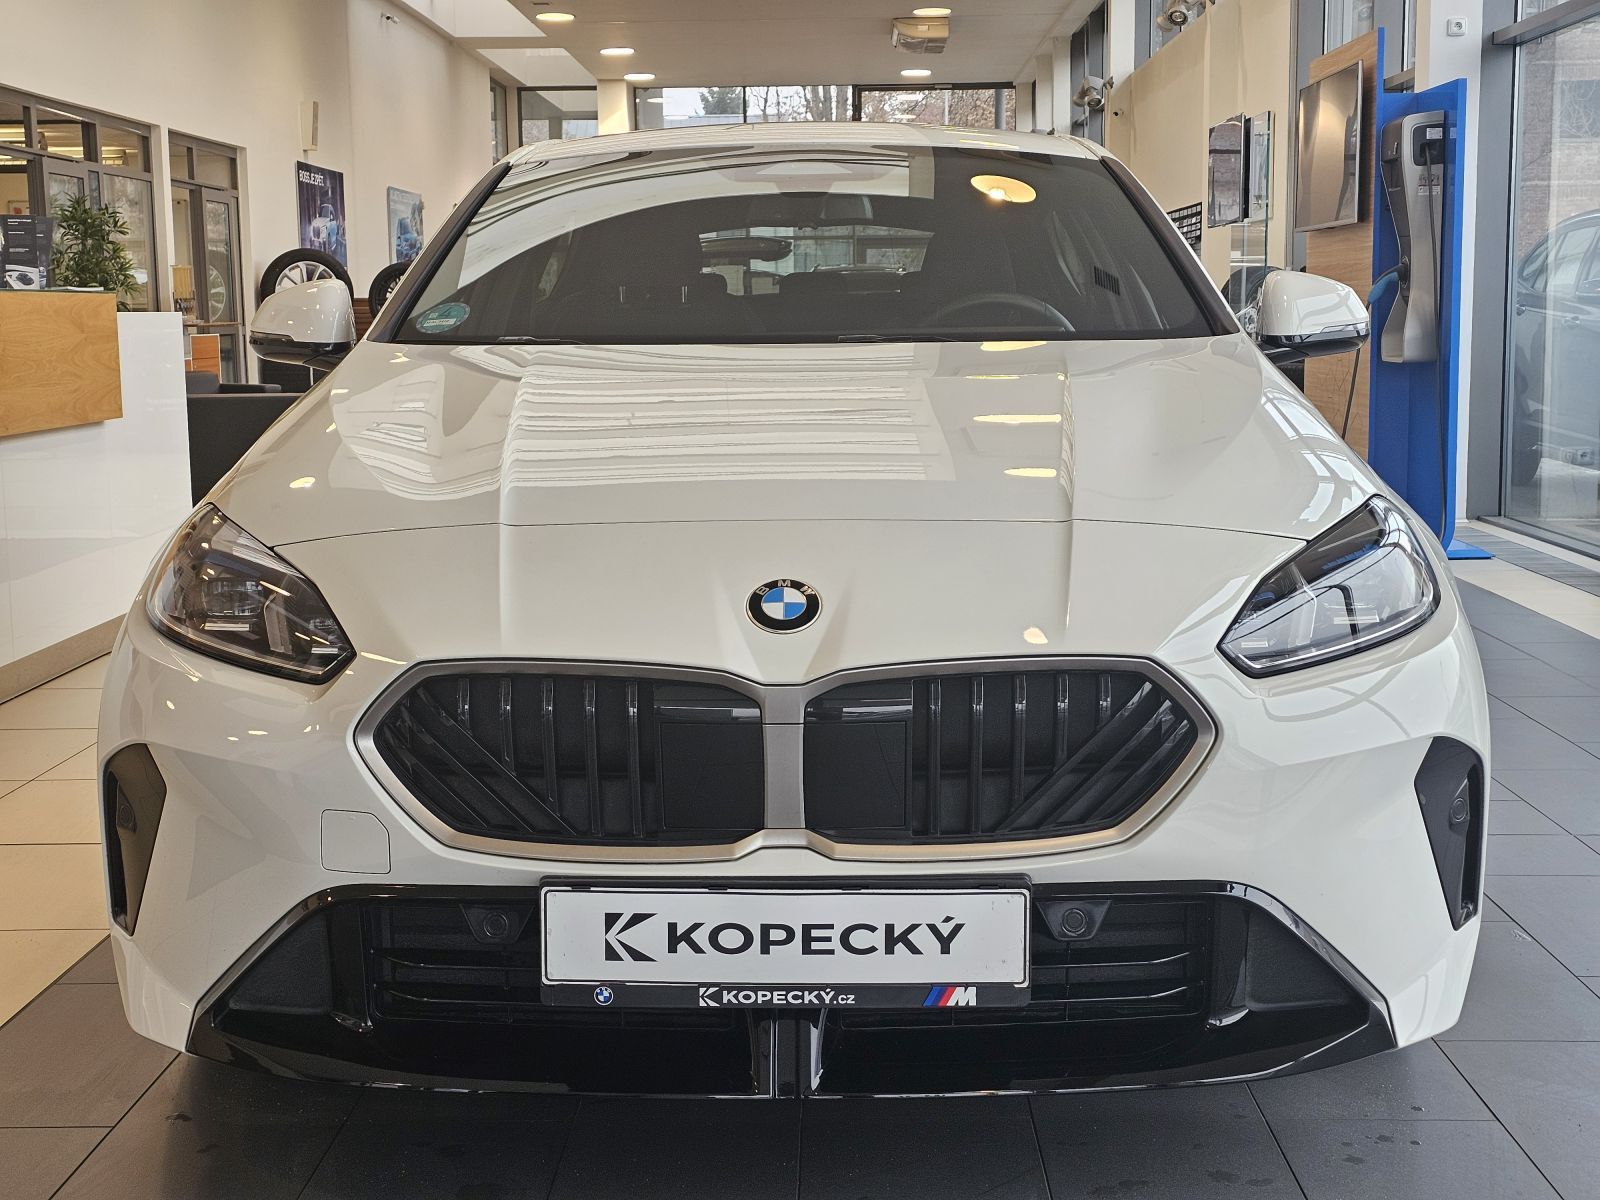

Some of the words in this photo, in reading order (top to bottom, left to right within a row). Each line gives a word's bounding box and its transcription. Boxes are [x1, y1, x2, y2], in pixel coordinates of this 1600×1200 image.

[756, 579, 816, 595] BMW
[667, 915, 966, 956] KOPECKÝ
[722, 988, 855, 1004] KOPECKÝ.cz
[946, 987, 977, 1006] M
